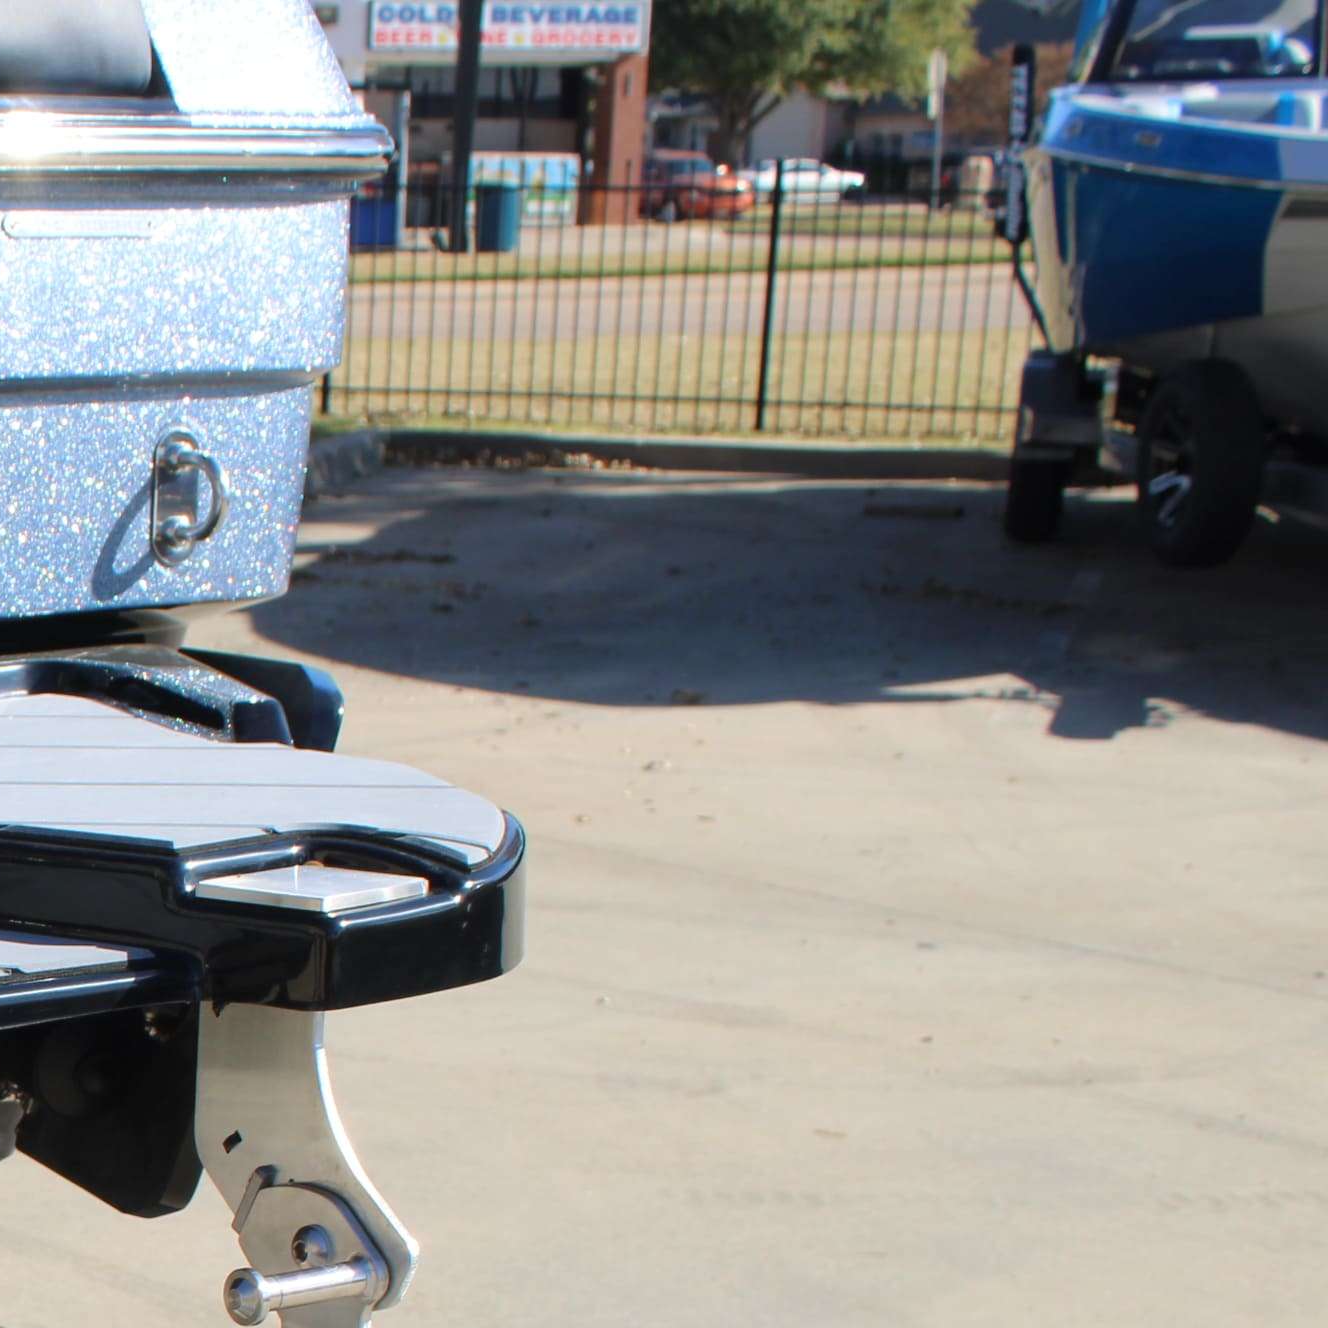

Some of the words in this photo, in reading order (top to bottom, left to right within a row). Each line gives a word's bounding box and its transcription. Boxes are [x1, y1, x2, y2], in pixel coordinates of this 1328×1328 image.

[377, 5, 454, 24] COLD
[490, 5, 639, 24] BEVERAGE
[375, 30, 434, 45] BEER
[532, 30, 637, 45] GROCERY
